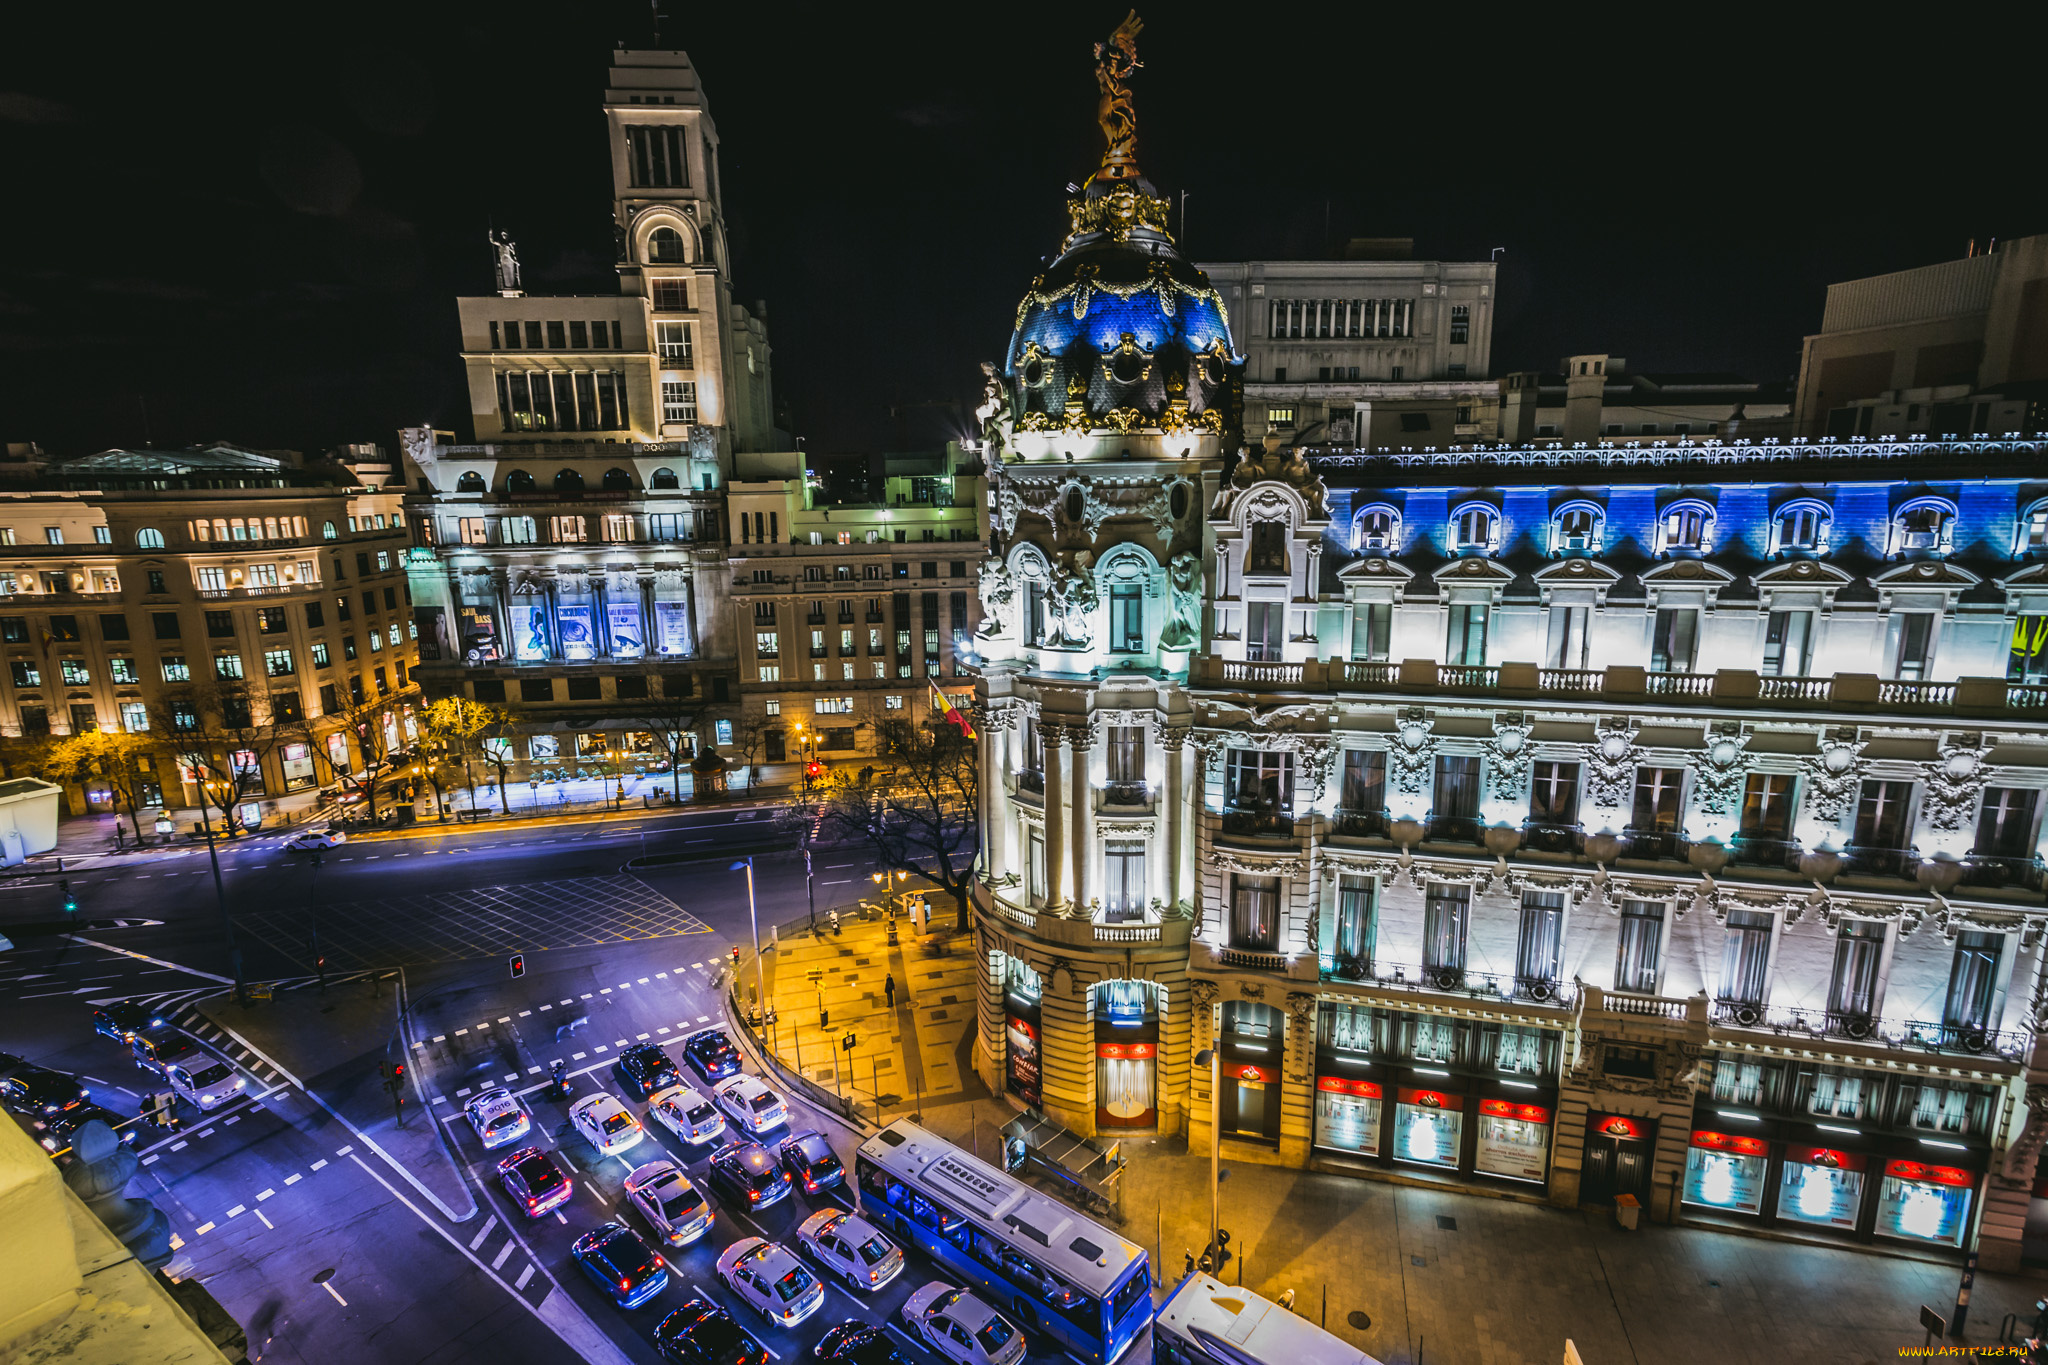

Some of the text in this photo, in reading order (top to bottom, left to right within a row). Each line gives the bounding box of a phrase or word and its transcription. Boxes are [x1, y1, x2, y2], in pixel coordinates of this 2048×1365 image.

[210, 538, 299, 550] EDIFICIO ZURICH
[460, 607, 478, 617] SAUL
[474, 614, 492, 624] BASS
[1335, 1081, 1376, 1094] Santander
[488, 1101, 511, 1114] 9016
[1499, 1105, 1545, 1118] Santander
[1713, 1136, 1763, 1151] Santander
[1912, 1165, 1966, 1181] Santander
